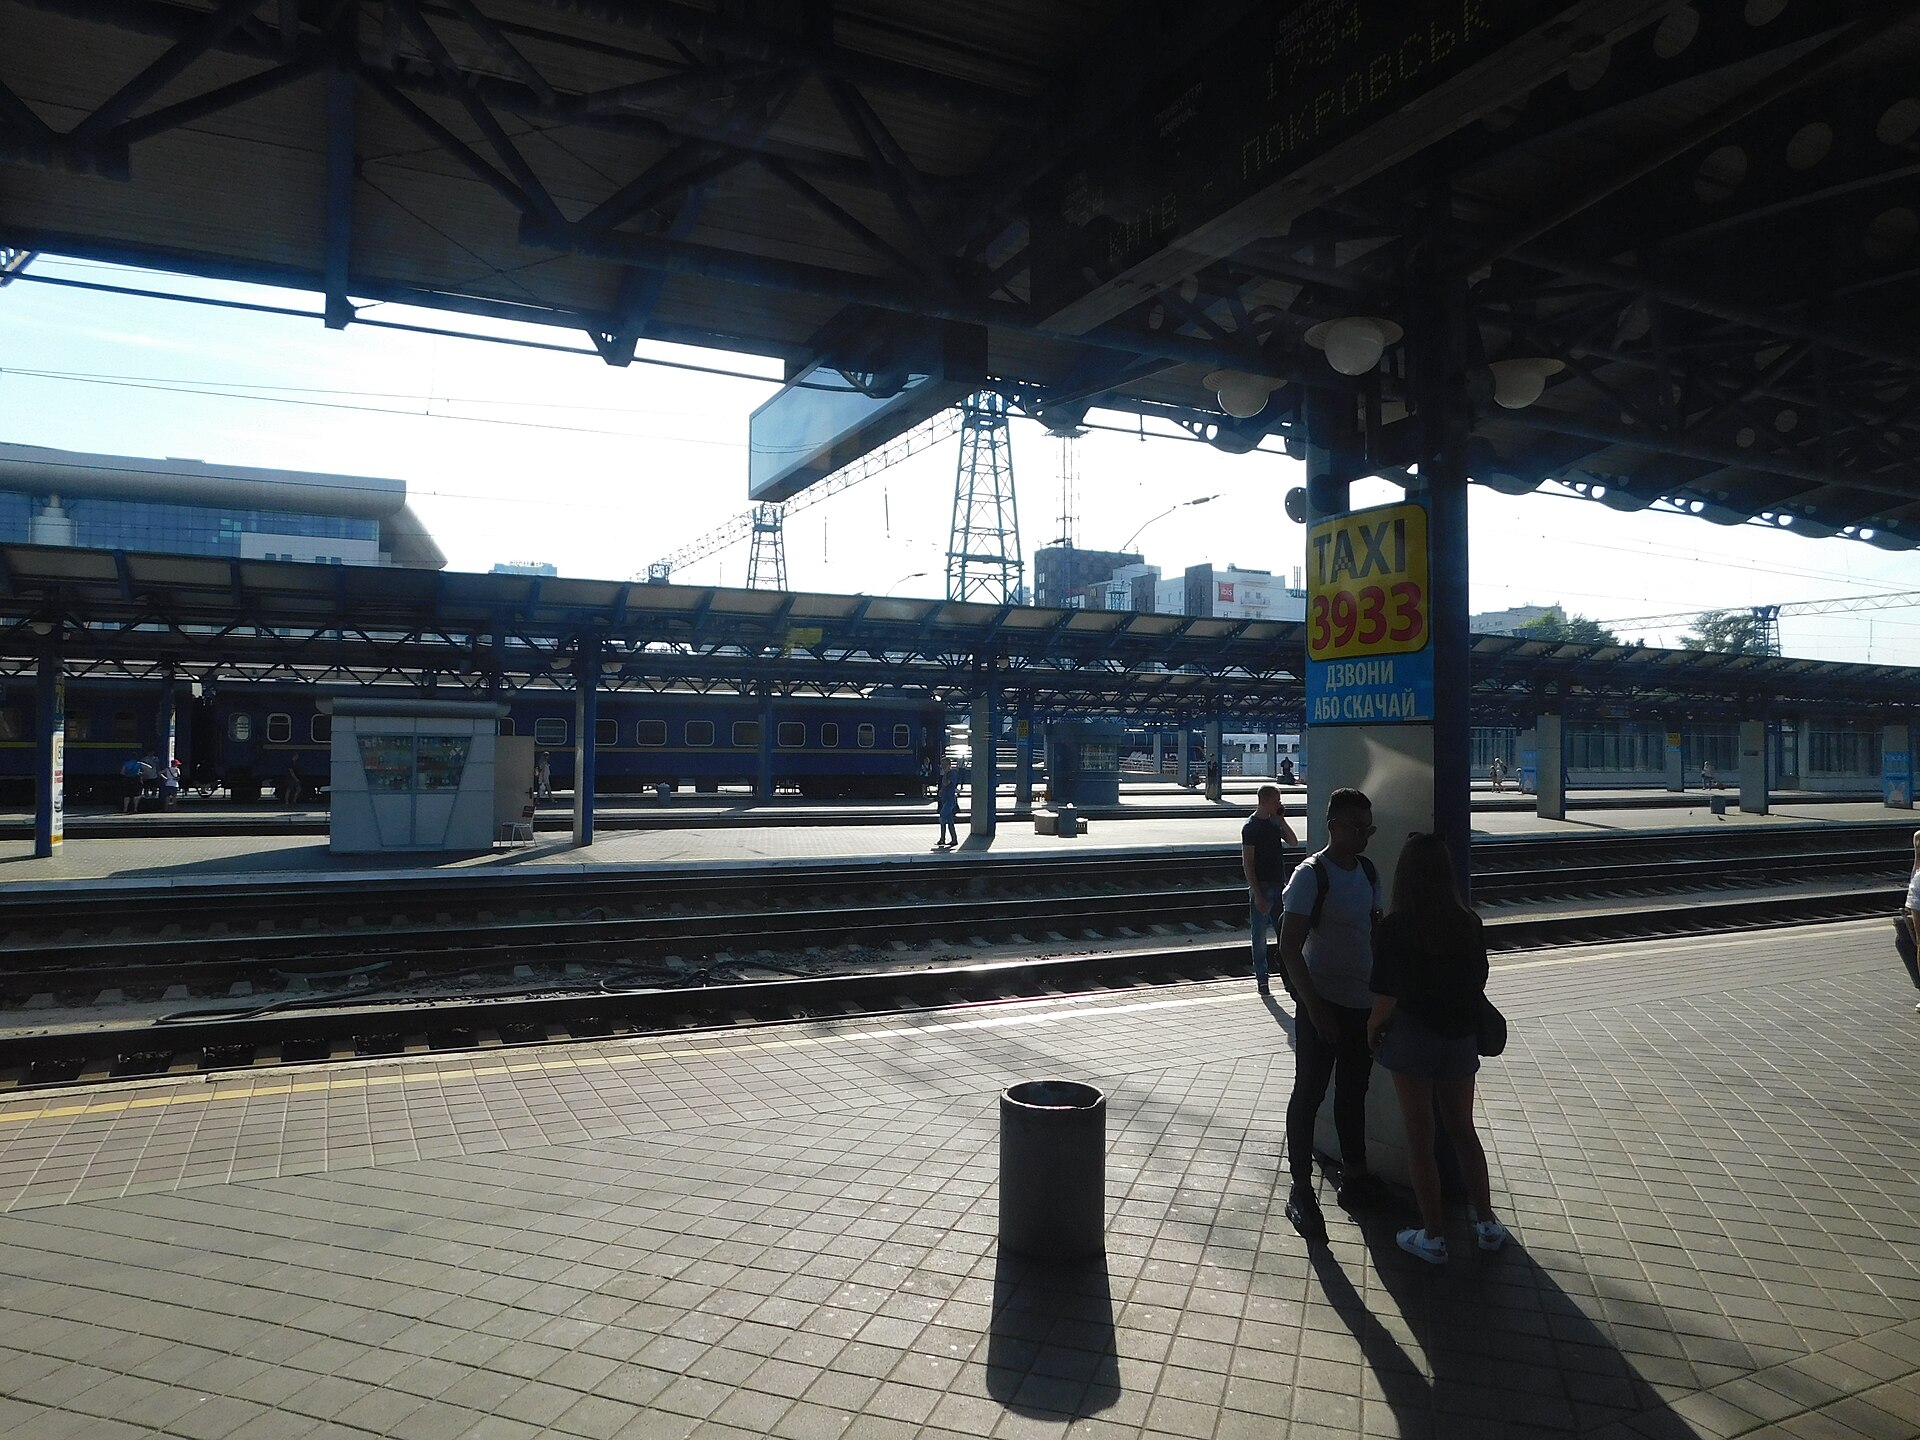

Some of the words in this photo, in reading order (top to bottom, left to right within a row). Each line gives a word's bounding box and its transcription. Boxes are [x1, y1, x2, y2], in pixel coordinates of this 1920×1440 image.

[1242, 0, 1490, 180] ПОКРОВСЬК
[1312, 518, 1406, 586] TAXI
[1312, 581, 1423, 651] 3933
[1314, 695, 1340, 721] АБО
[1343, 687, 1416, 720] СКАЧАЙ
[1325, 660, 1394, 692] ДЗВОНИ
